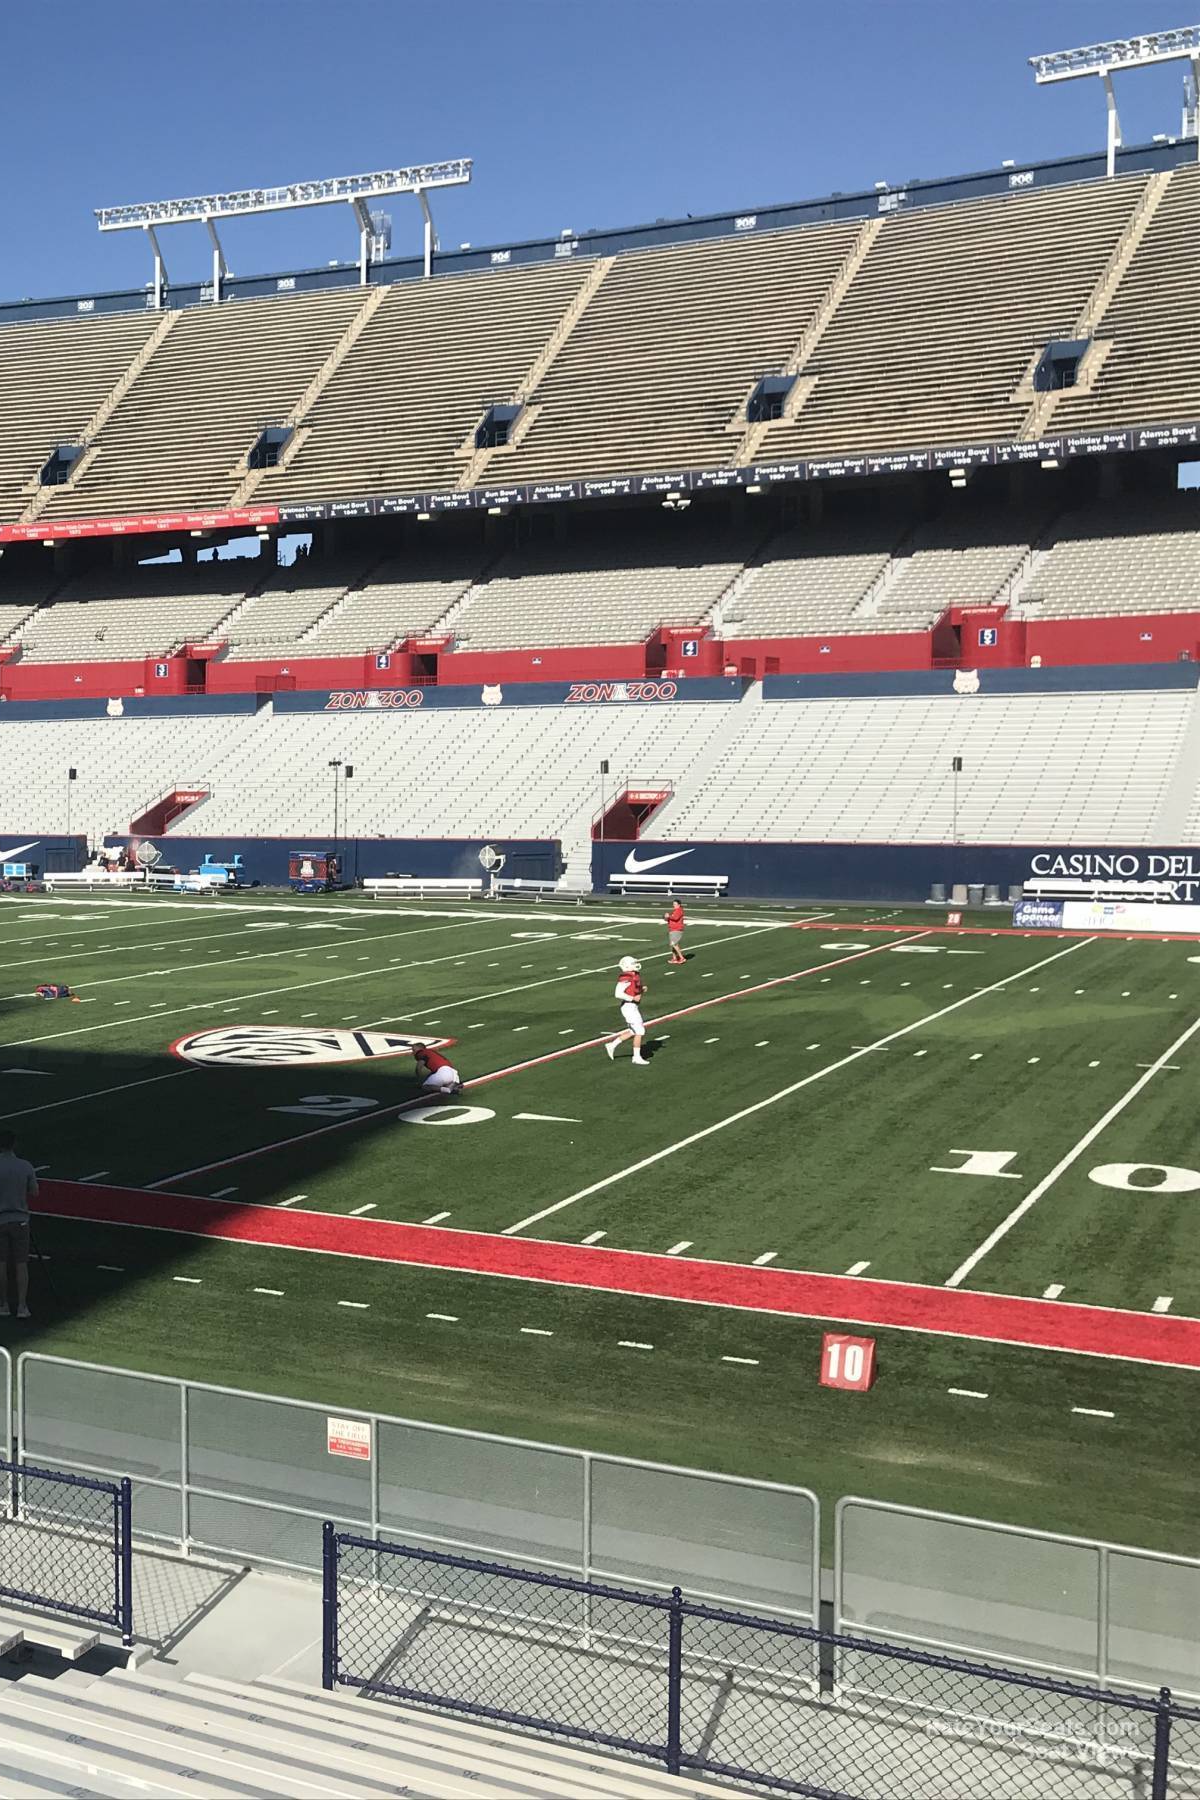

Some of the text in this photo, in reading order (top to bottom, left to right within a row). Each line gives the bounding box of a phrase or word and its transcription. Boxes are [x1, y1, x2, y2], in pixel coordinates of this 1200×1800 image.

[1140, 427, 1197, 439] Alamo Bowl
[1068, 433, 1127, 446] Holiday Bowl
[997, 440, 1060, 454] Las Vegas Bowl
[869, 453, 928, 466] Insight.com Bowl
[935, 448, 989, 460] Holiday Bowl
[755, 465, 799, 475] Fiesta Bowl
[809, 459, 864, 470] Freedom Bowl
[718, 470, 737, 478] Bowl
[584, 479, 630, 490] Copper Bowl
[642, 475, 684, 485] Aloha Bowl
[555, 484, 572, 492] Bowl
[351, 501, 367, 509] Bowl
[398, 497, 415, 505] Bowl
[1030, 853, 1200, 877] CASINO DEL
[1023, 905, 1055, 914] Game
[1016, 913, 1060, 923] Sponsor
[827, 1343, 864, 1382] 10
